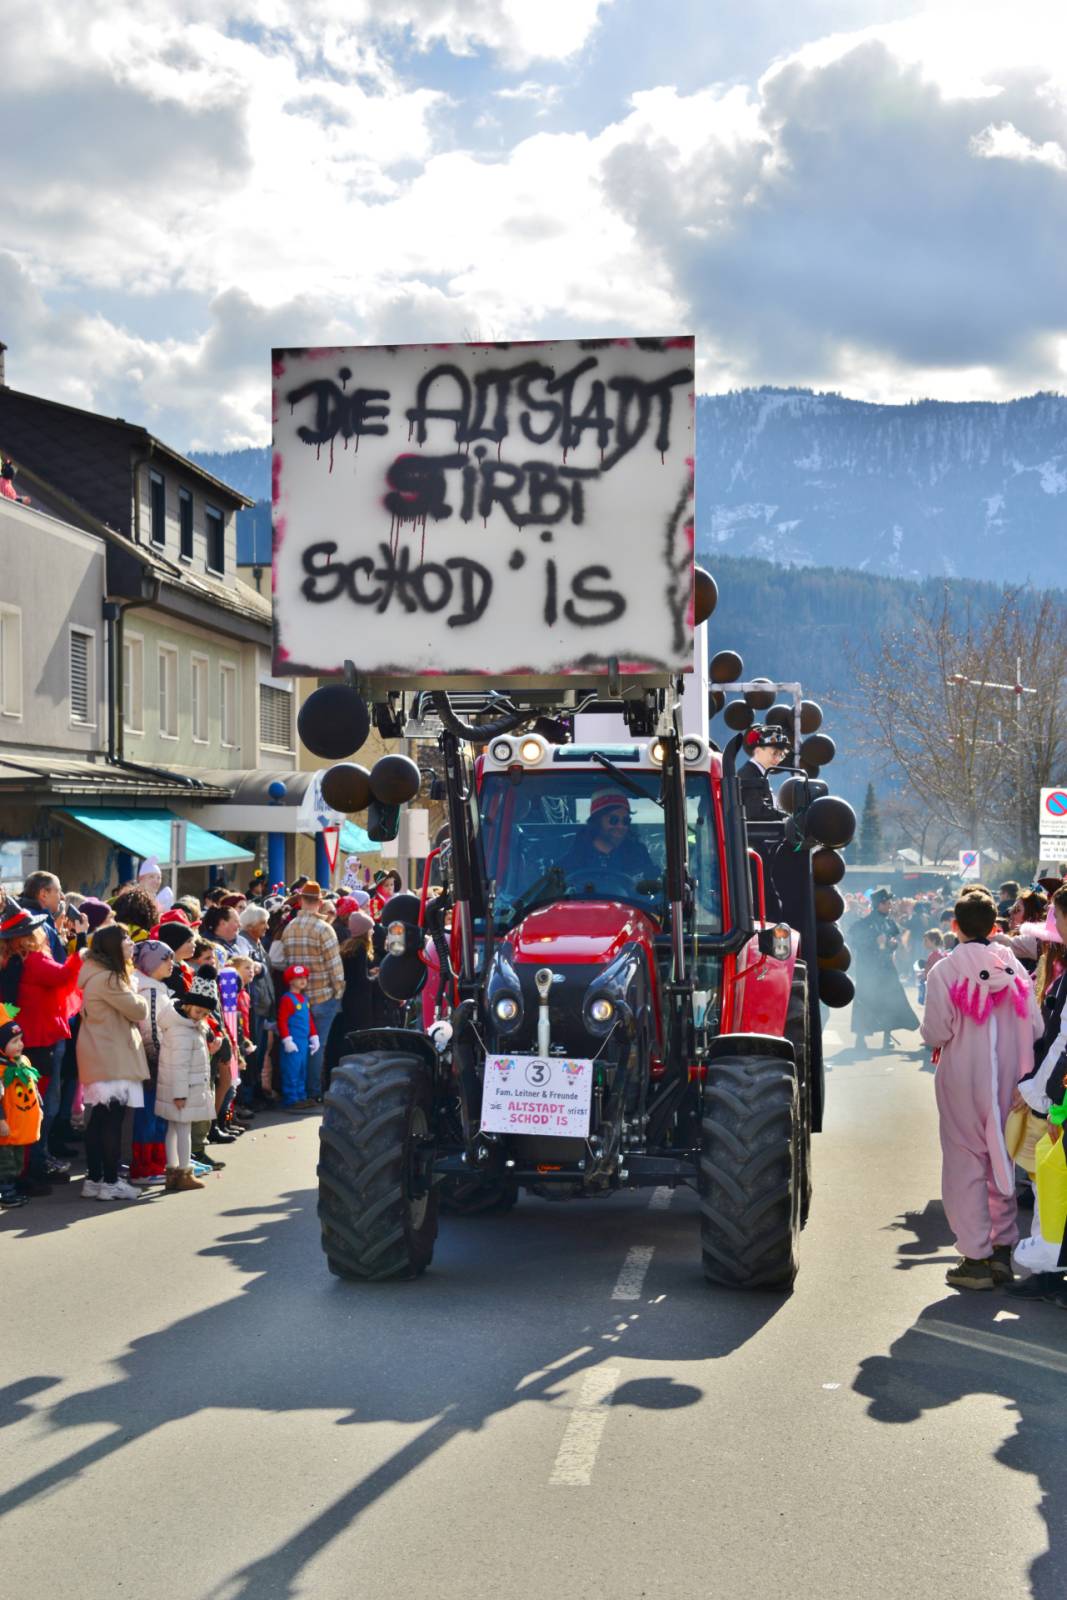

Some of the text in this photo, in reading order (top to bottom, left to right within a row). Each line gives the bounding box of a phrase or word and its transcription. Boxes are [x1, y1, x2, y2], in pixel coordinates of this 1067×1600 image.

[406, 357, 695, 455] ALTSTADT
[384, 446, 602, 526] STIRBT
[532, 1065, 544, 1083] 3
[495, 1088, 578, 1100] Fam. Leitner & Freunde
[508, 1101, 565, 1114] ALTSTADT
[556, 1116, 568, 1126] IS
